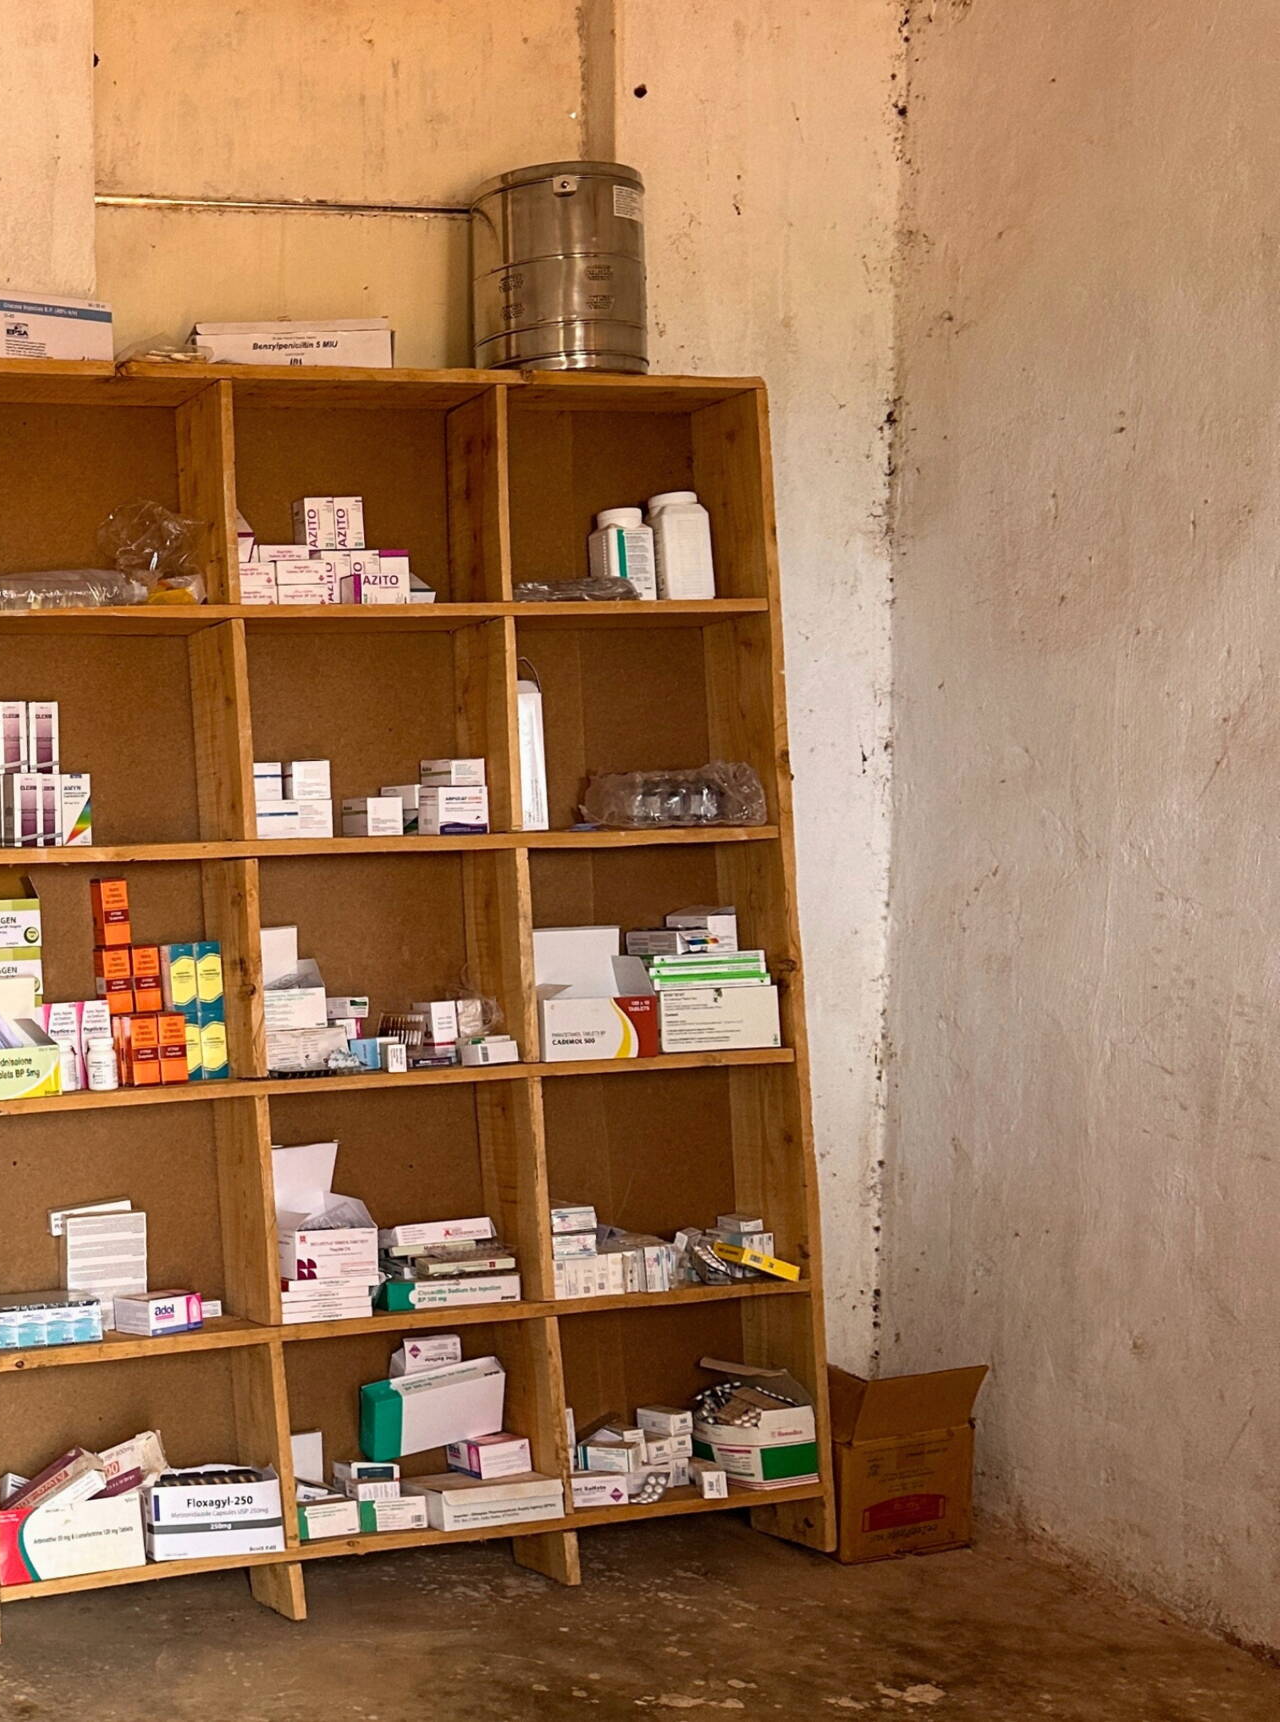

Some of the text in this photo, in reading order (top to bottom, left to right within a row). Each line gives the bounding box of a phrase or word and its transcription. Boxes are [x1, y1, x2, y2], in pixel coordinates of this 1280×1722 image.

[252, 341, 314, 352] Benzylpenicillin
[307, 508, 320, 549] AZITO
[336, 507, 348, 549] AZITO
[362, 574, 400, 587] AZITO
[14, 1069, 25, 1079] BP
[26, 1067, 41, 1080] 5mg
[153, 1303, 175, 1317] adol
[186, 1495, 254, 1510] Floxagyl-250
